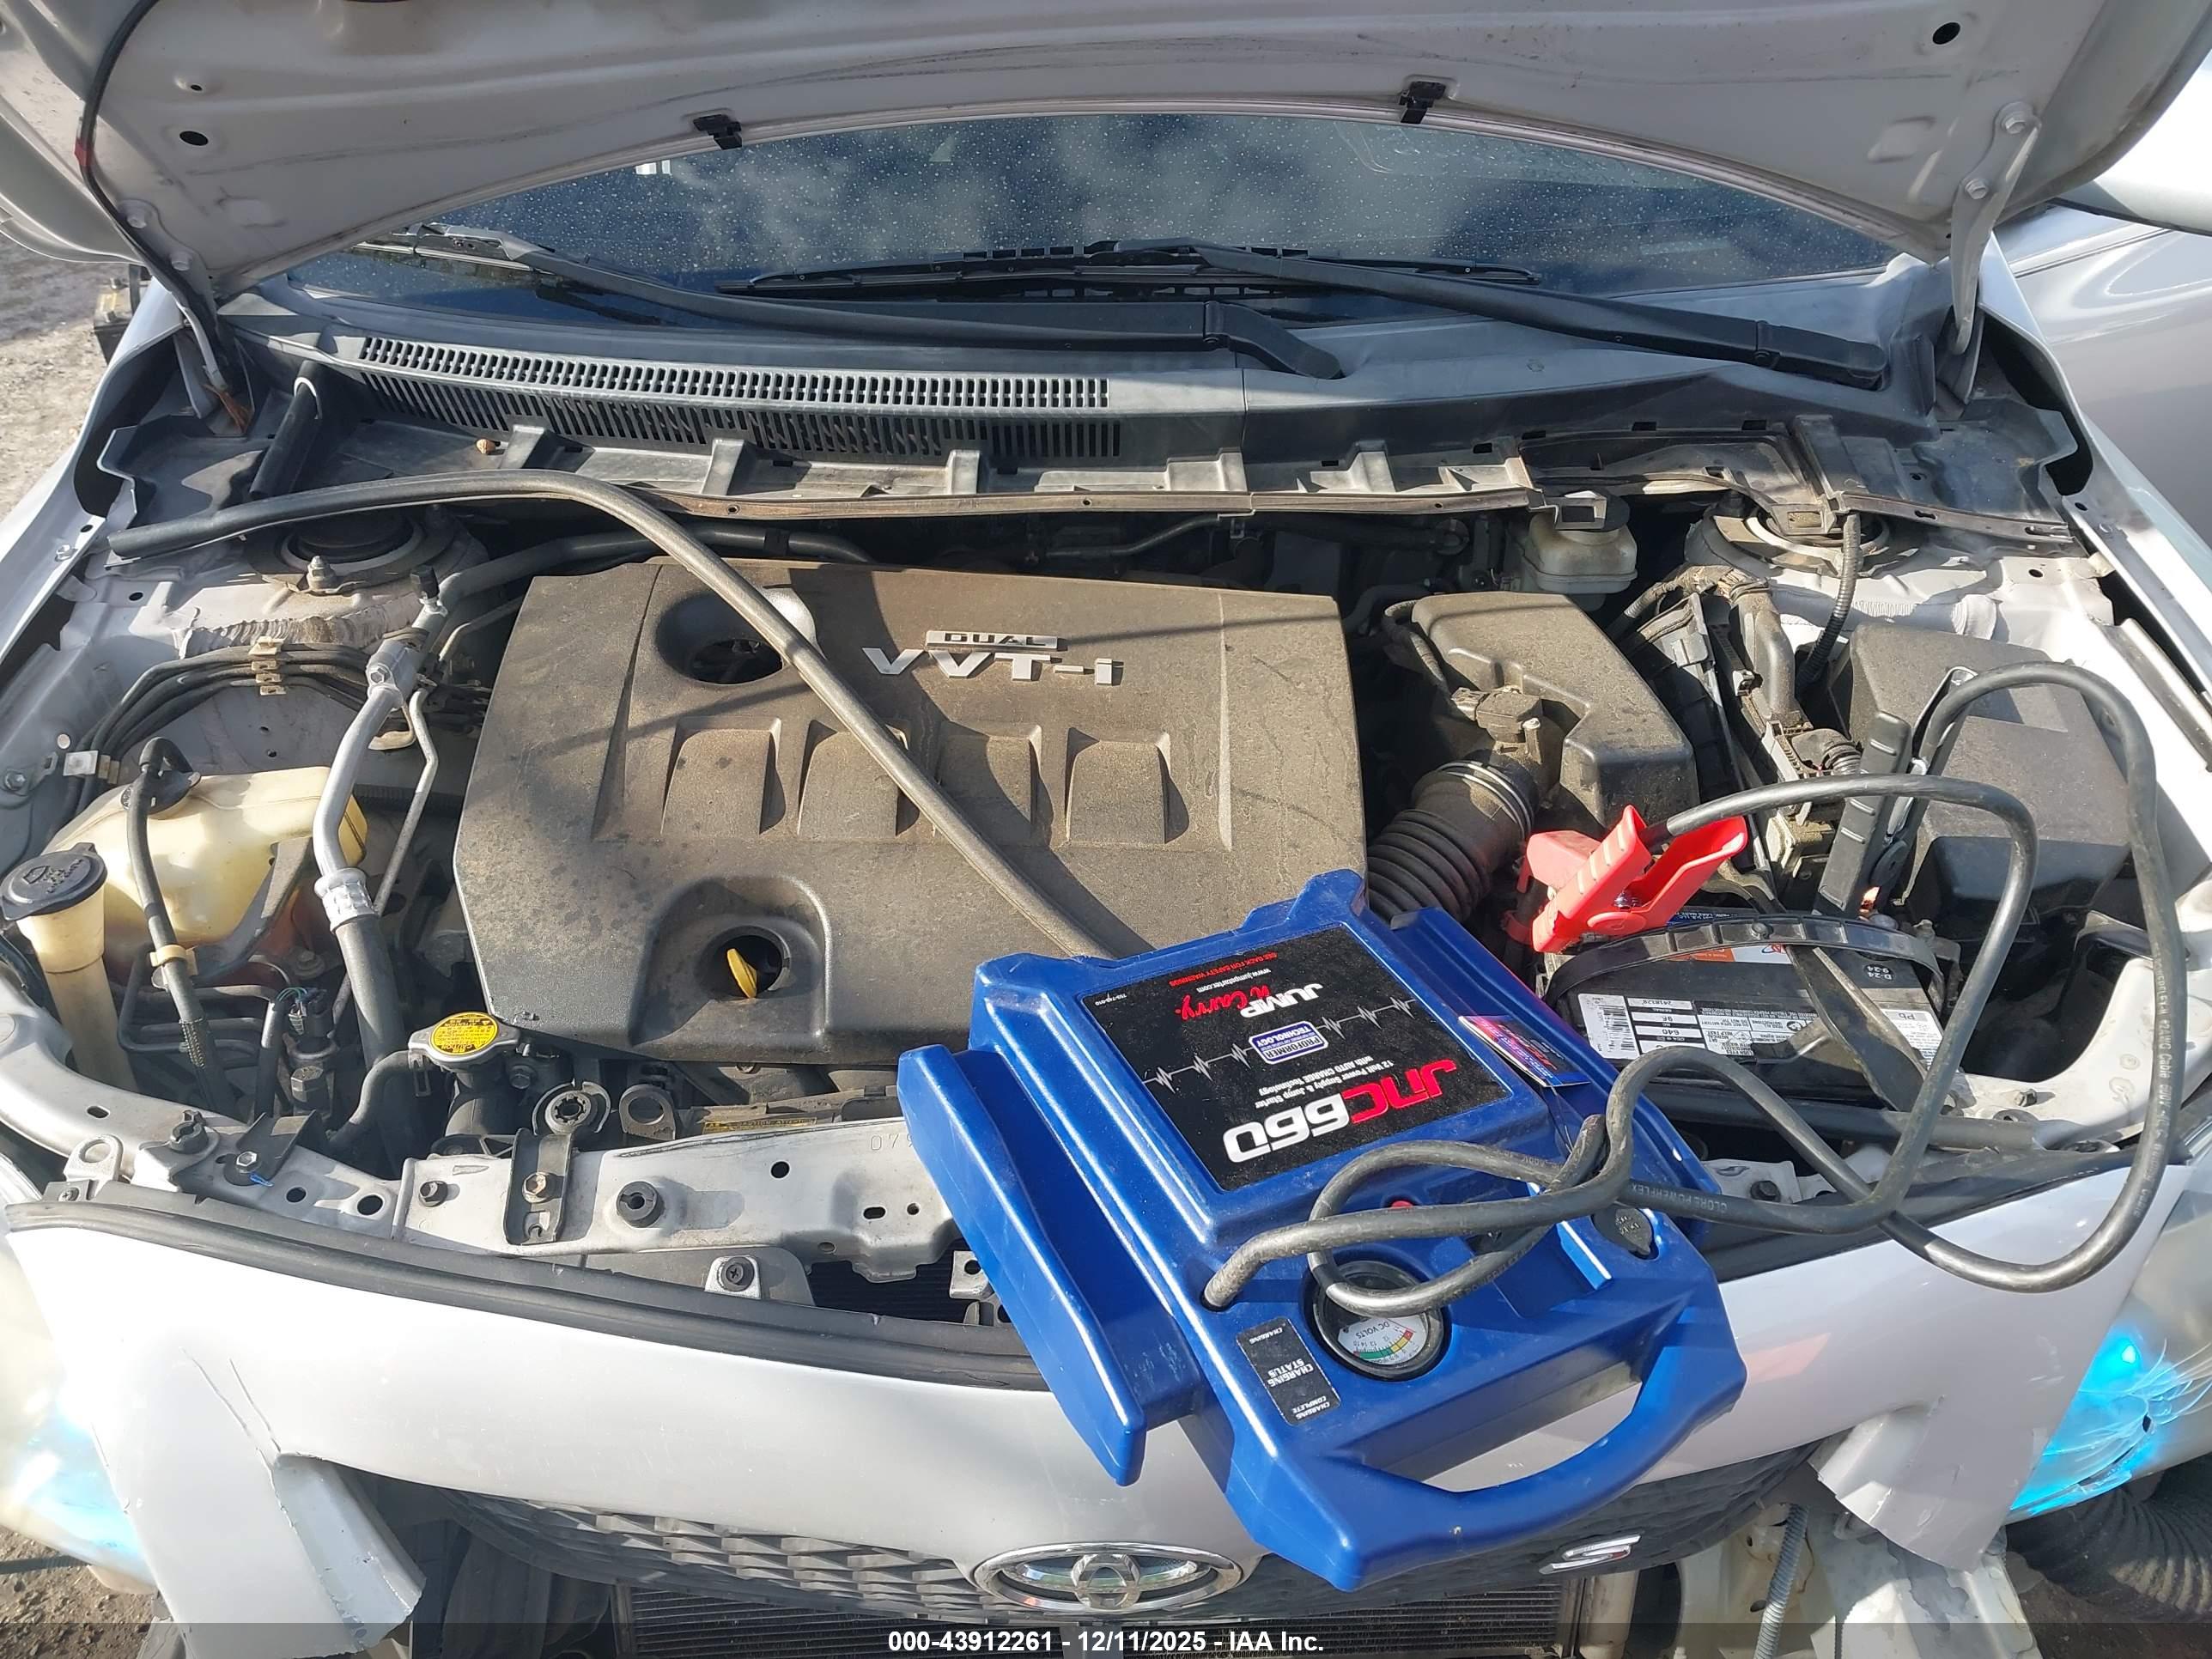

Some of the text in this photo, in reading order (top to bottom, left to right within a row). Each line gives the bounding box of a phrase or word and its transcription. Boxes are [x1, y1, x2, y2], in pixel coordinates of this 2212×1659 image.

[945, 631, 1046, 647] DUAL
[1196, 968, 1270, 992] www.jumpstarter.com
[1239, 982, 1322, 1018] JUMP
[1255, 1024, 1310, 1046] TECHNOLOGY
[1265, 1036, 1320, 1058] PROFORMER
[1365, 1062, 1382, 1073] Volt
[1382, 1059, 1393, 1068] 12
[1258, 1055, 1372, 1097] with AUTO CHARGE Technology
[1313, 1075, 1341, 1091] Supply
[1341, 1067, 1366, 1081] Power
[1255, 1095, 1283, 1109] Starter
[1282, 1087, 1305, 1100] Jump
[1355, 1321, 1389, 1339] DC VOLTS
[1267, 1358, 1304, 1376] STATUS
[1267, 1363, 1313, 1387] CHARGING
[1291, 1395, 1326, 1413] COMPLETE
[1295, 1401, 1329, 1419] CHARGING
